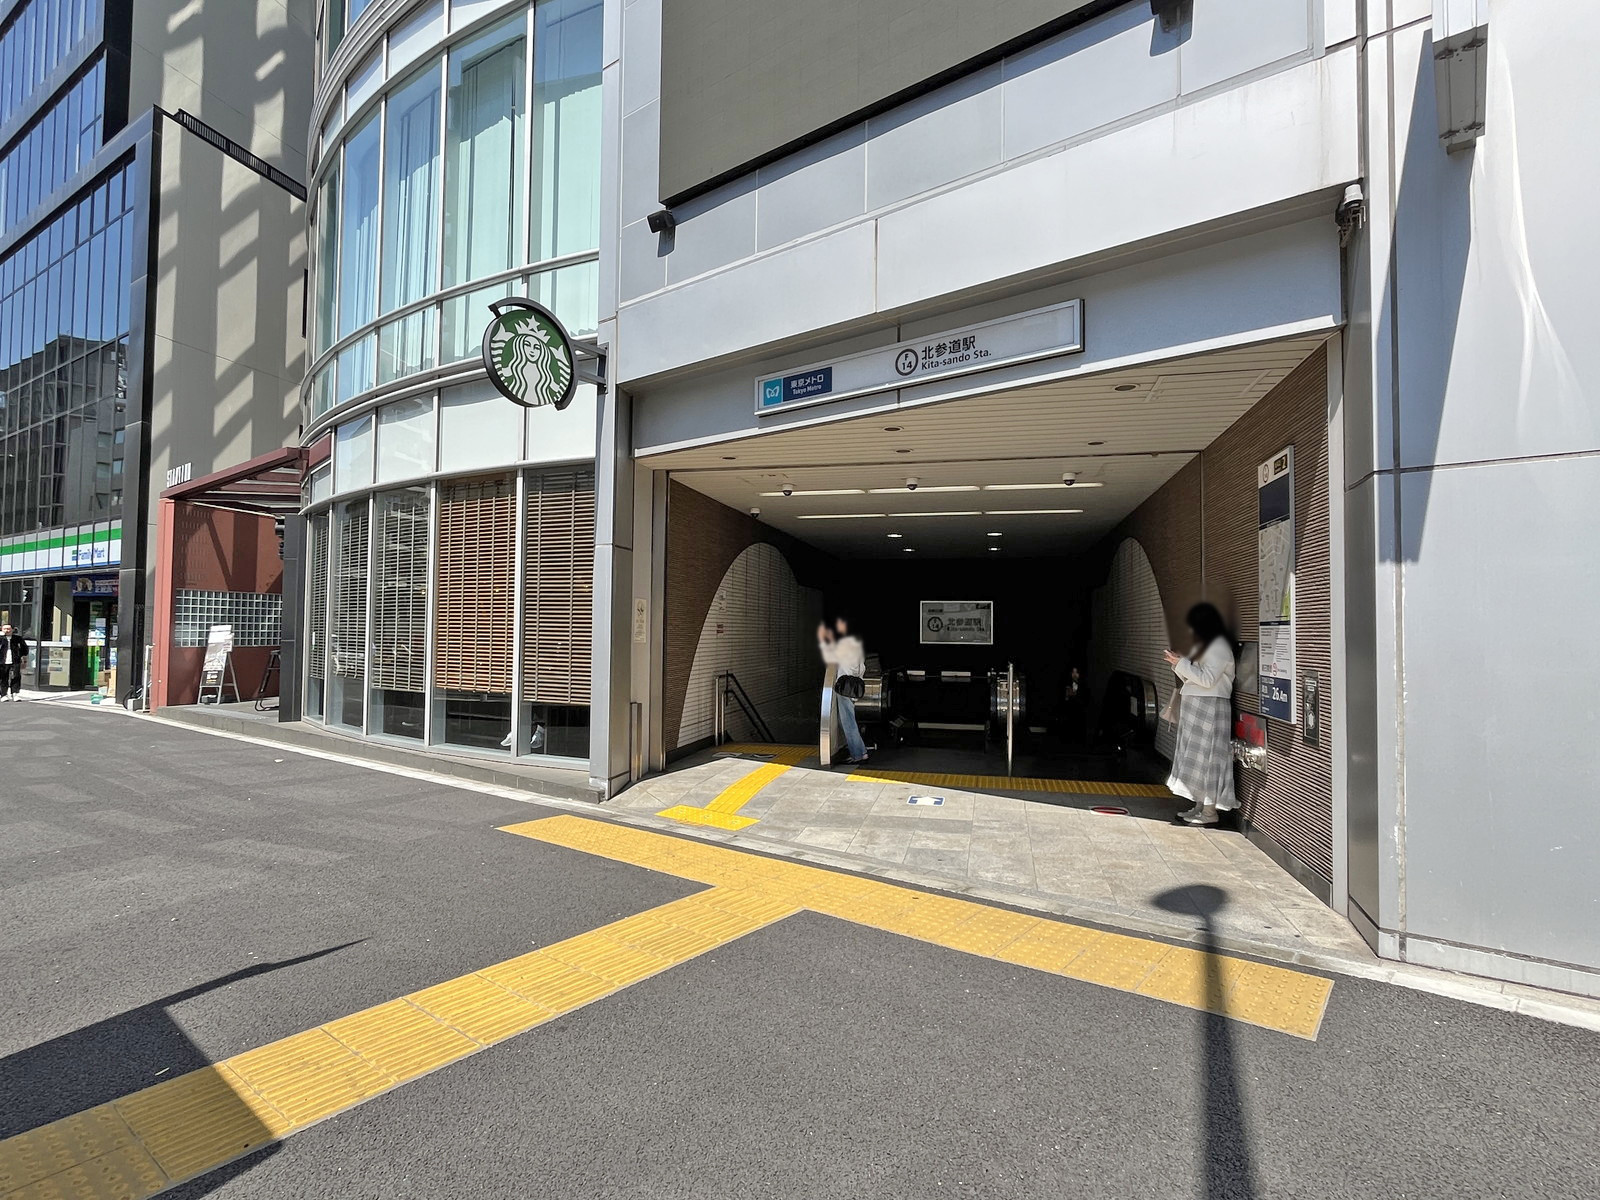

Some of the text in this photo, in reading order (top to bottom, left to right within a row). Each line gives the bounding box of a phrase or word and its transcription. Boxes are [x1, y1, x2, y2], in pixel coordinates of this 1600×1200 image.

[921, 335, 976, 361] 北参道駅
[904, 353, 909, 361] F
[921, 349, 992, 370] Kita-sando Sta.
[902, 360, 913, 370] 14
[790, 374, 824, 389] 東京メトロ
[792, 384, 822, 395] Tokyo Metro
